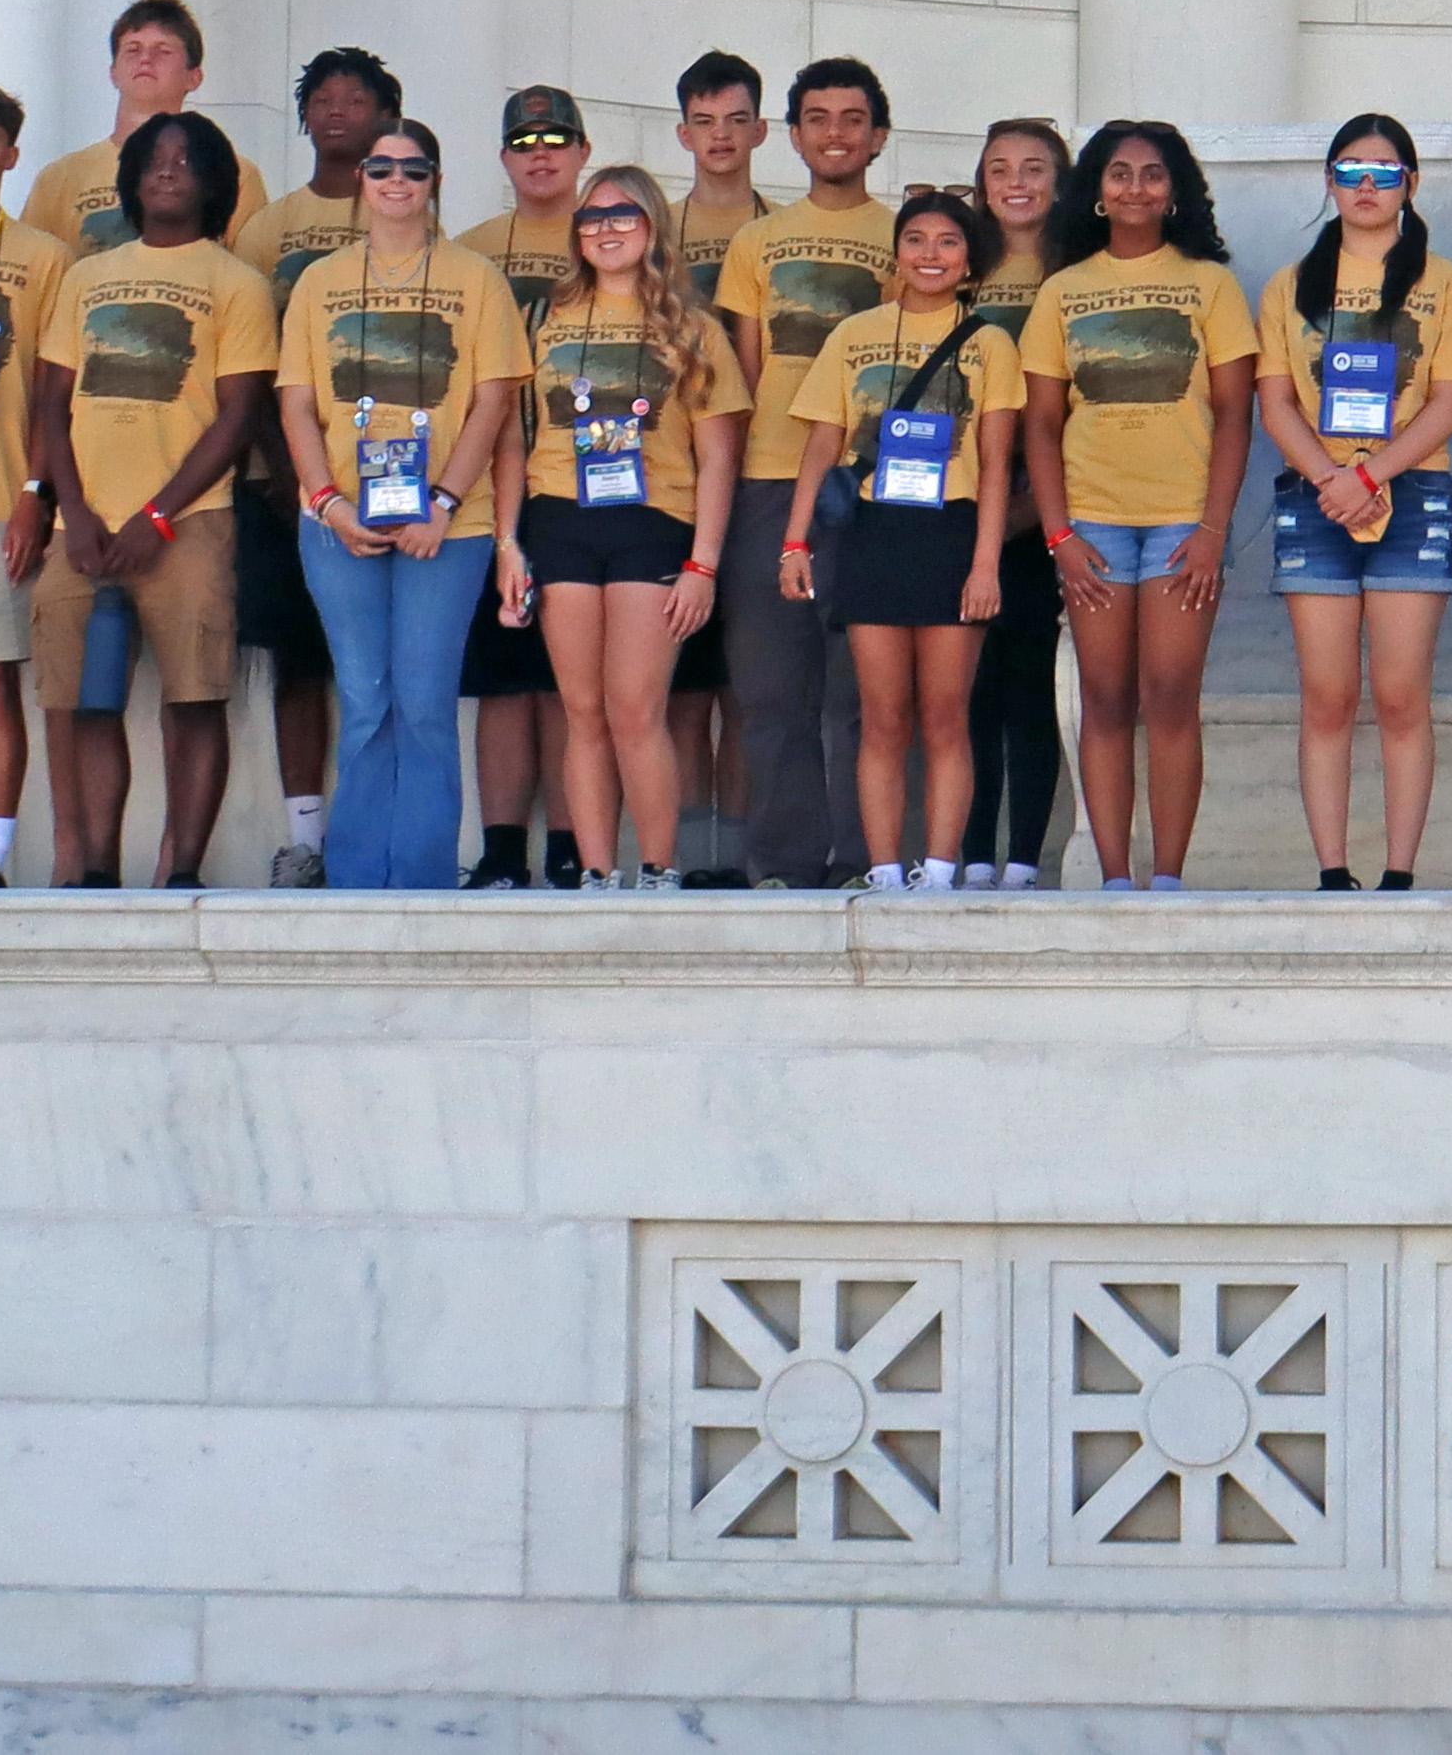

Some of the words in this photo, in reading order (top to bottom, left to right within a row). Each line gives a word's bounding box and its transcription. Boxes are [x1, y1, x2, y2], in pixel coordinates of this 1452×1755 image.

[75, 195, 117, 212] YOU
[280, 234, 332, 253] OUTH
[685, 247, 727, 262] UTH
[762, 245, 834, 264] YOUTH
[842, 248, 897, 275] TOUR
[541, 261, 570, 276] TO
[82, 288, 148, 308] YOUTH
[154, 288, 213, 316] TOUR
[979, 291, 1024, 303] UTH
[1062, 288, 1117, 301] ELECTRIC
[323, 296, 400, 314] YOUTH
[408, 297, 465, 316] TOUR
[1060, 293, 1135, 318] YOUTH
[1143, 293, 1201, 307] TOUR
[846, 351, 919, 370] YOUTH
